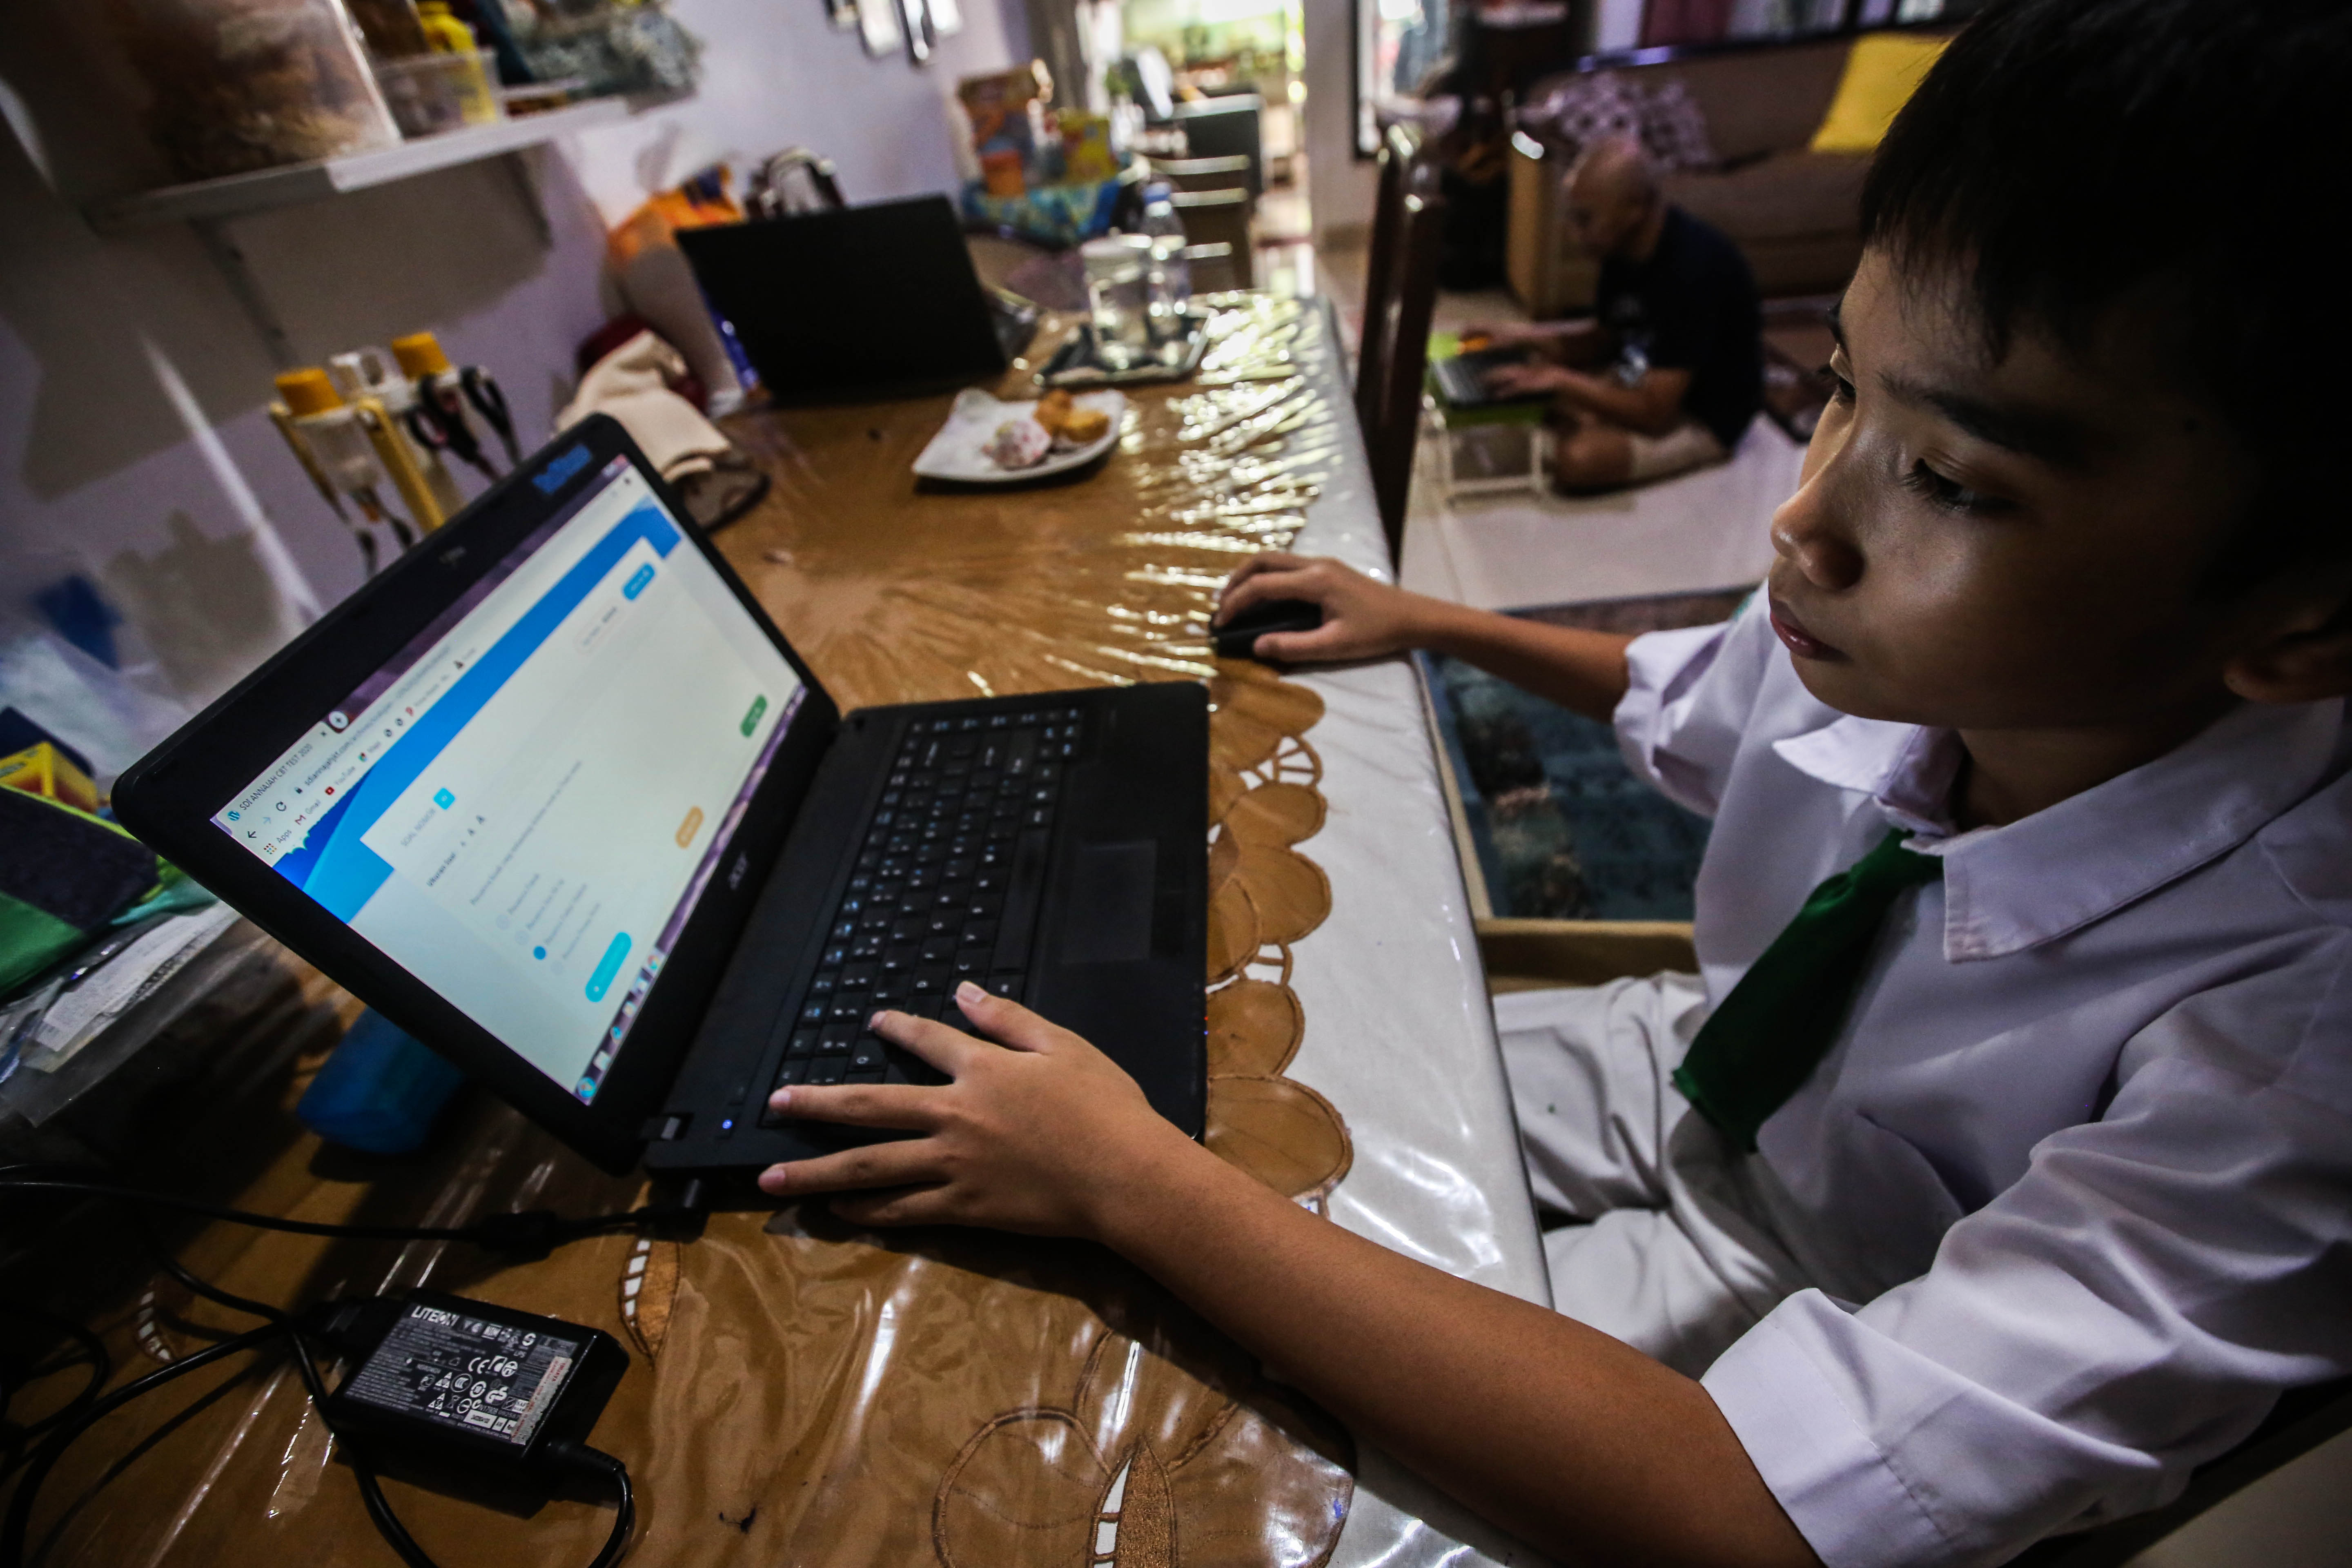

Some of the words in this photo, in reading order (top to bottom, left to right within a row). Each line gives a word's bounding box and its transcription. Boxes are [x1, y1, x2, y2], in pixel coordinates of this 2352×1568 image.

[239, 799, 252, 810] SDI
[250, 777, 278, 801] ANNAJAH
[276, 765, 287, 777] CBT
[286, 754, 299, 768] TEST
[276, 829, 292, 844] Apps
[305, 799, 321, 814] Gmail
[411, 1305, 460, 1326] LITEON
[468, 1356, 490, 1374] CE
